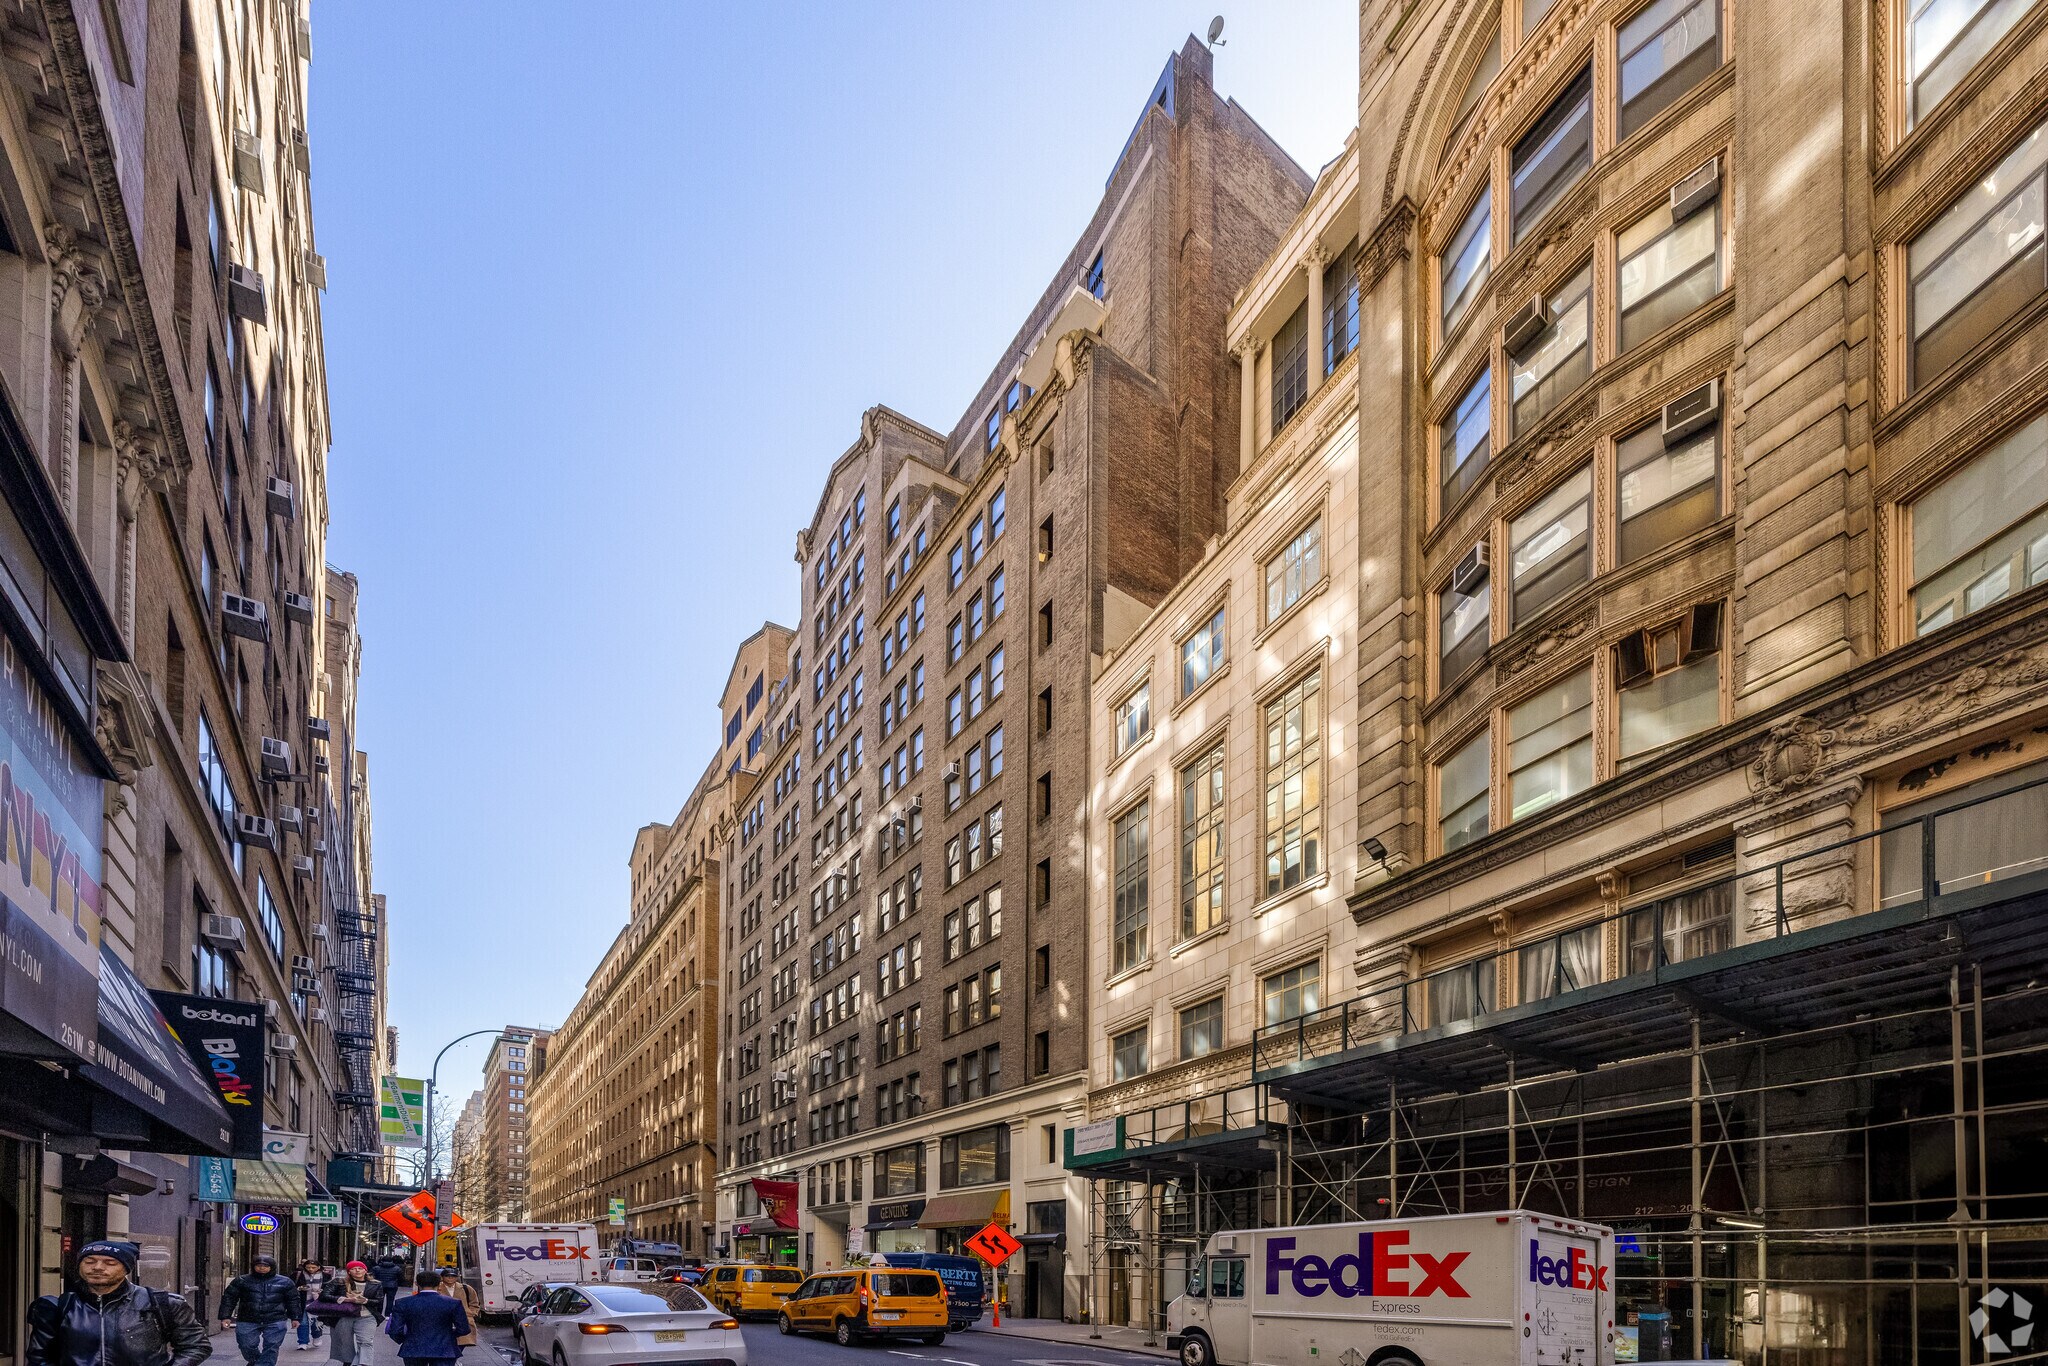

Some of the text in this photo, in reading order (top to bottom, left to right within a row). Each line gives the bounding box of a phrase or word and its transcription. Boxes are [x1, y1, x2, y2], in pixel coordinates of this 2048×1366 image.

[25, 665, 74, 776] VINYL
[19, 715, 43, 762] HEAT
[46, 753, 73, 802] PRESS
[182, 1004, 257, 1028] botani
[61, 1022, 84, 1054] 261W
[201, 1038, 252, 1106] Blanks
[389, 1080, 413, 1133] #GarmentDistrict
[1563, 1176, 1632, 1191] DSIGN
[298, 1203, 338, 1218] BEER
[880, 1203, 909, 1220] GENUINE
[486, 1239, 592, 1261] FedEx
[1266, 1229, 1472, 1298] FedEx
[1372, 1300, 1421, 1314] Express
[1571, 1294, 1593, 1305] Express
[1373, 1323, 1425, 1335] fedex.com
